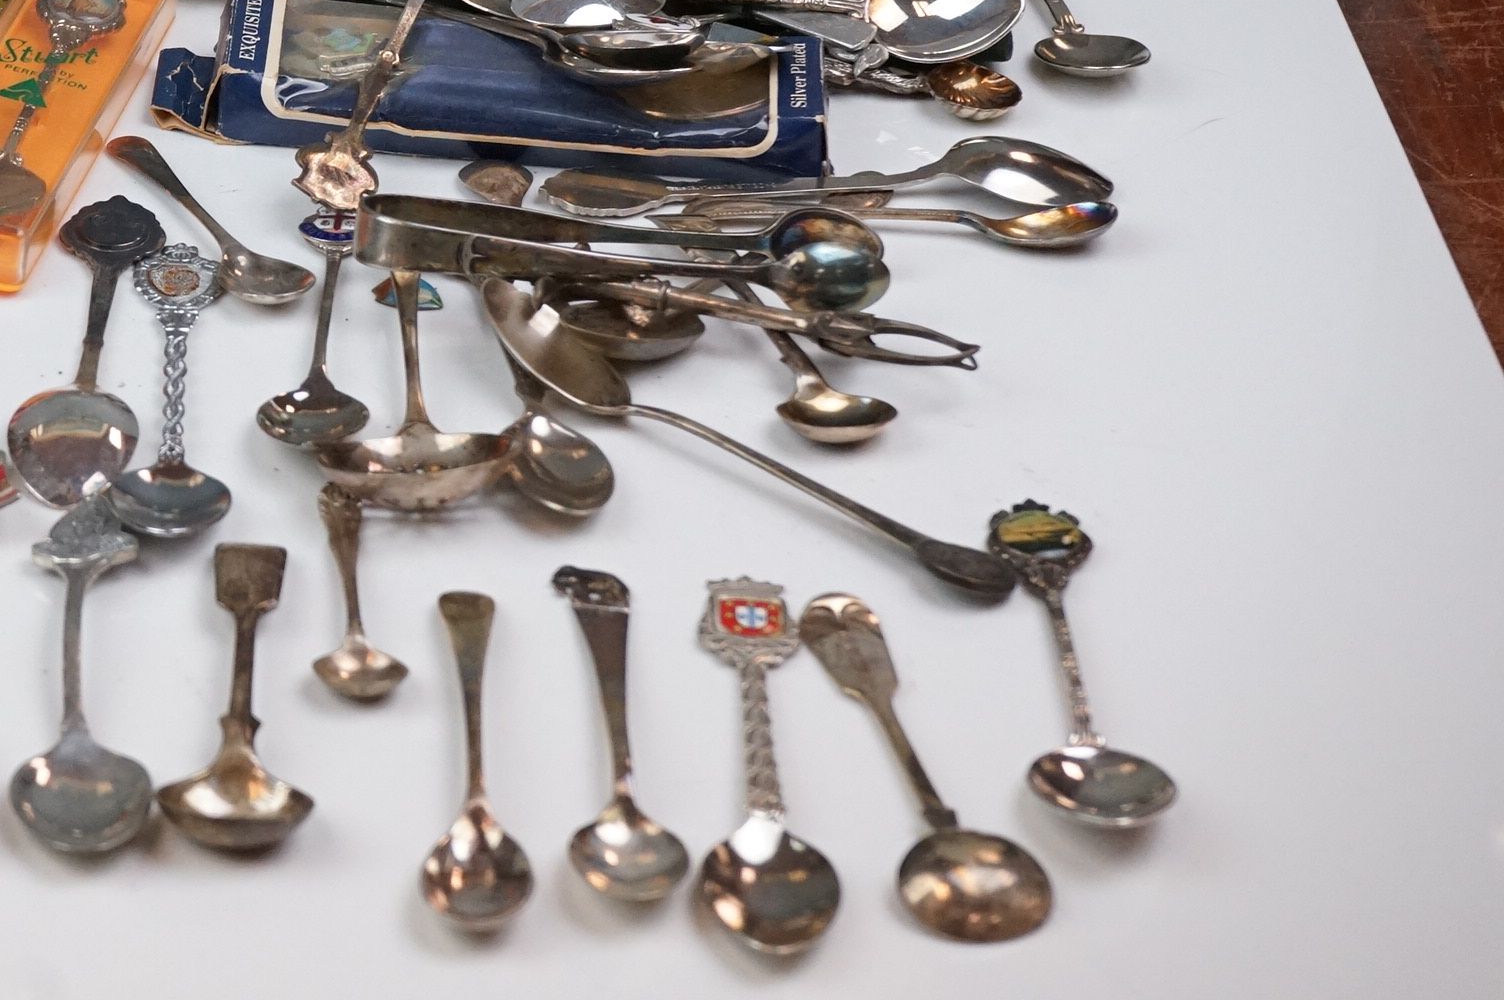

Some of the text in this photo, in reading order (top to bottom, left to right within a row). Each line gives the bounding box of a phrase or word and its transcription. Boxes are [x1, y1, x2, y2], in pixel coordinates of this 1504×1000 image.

[4, 63, 88, 91] PERFTION
[789, 42, 808, 109] Silver Plated
